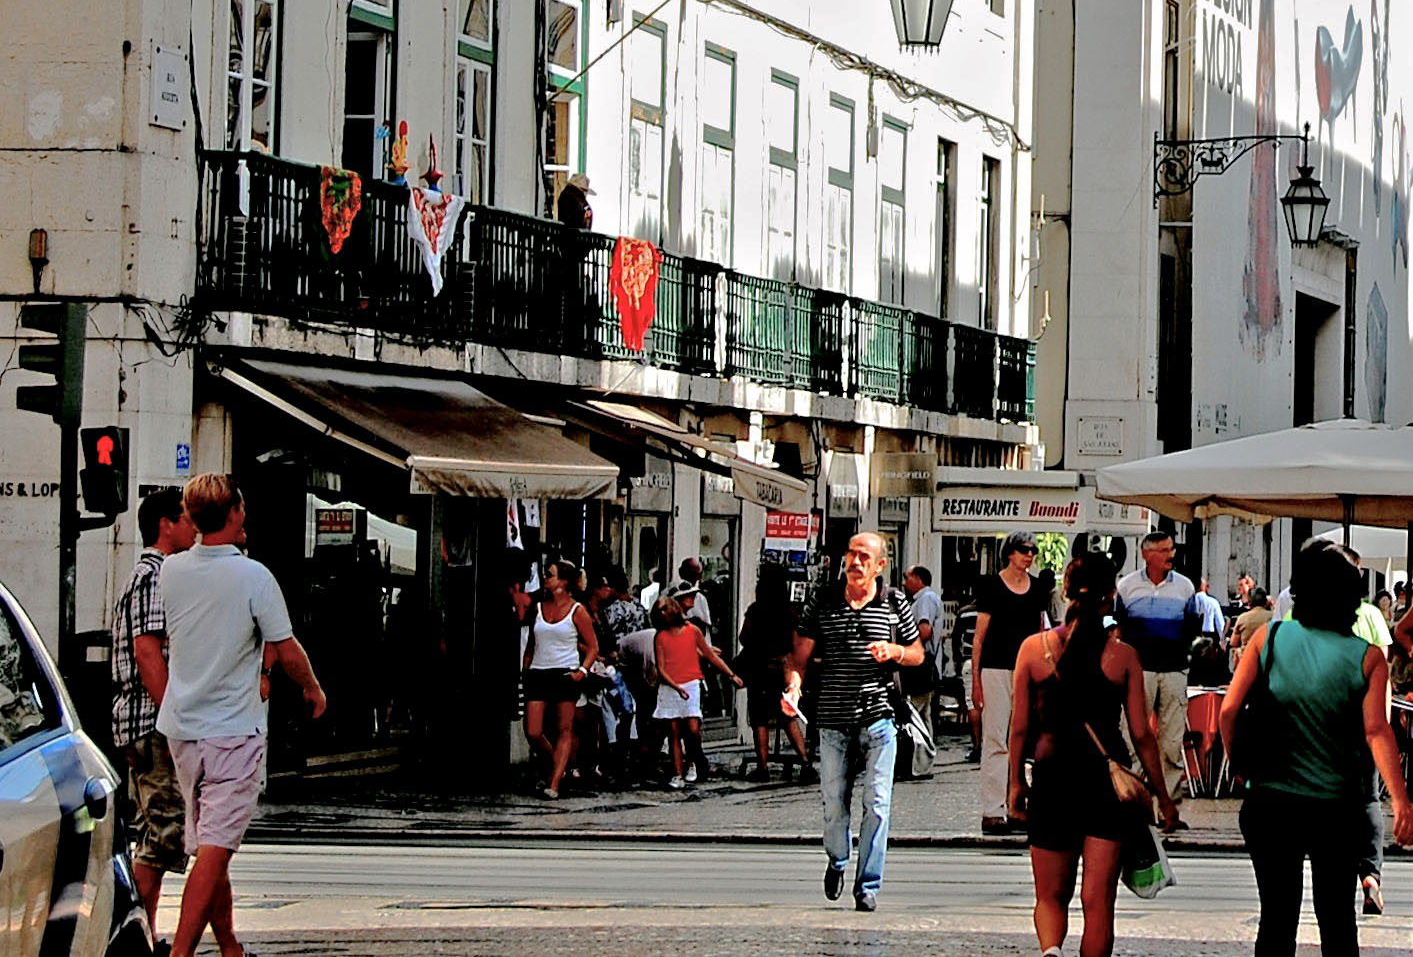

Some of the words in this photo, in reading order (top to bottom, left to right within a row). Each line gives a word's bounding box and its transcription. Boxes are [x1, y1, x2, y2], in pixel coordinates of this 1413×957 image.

[1202, 9, 1244, 102] MODA
[17, 482, 28, 497] &
[941, 498, 1020, 517] RESTAURANTE
[1029, 500, 1080, 519] Buondi
